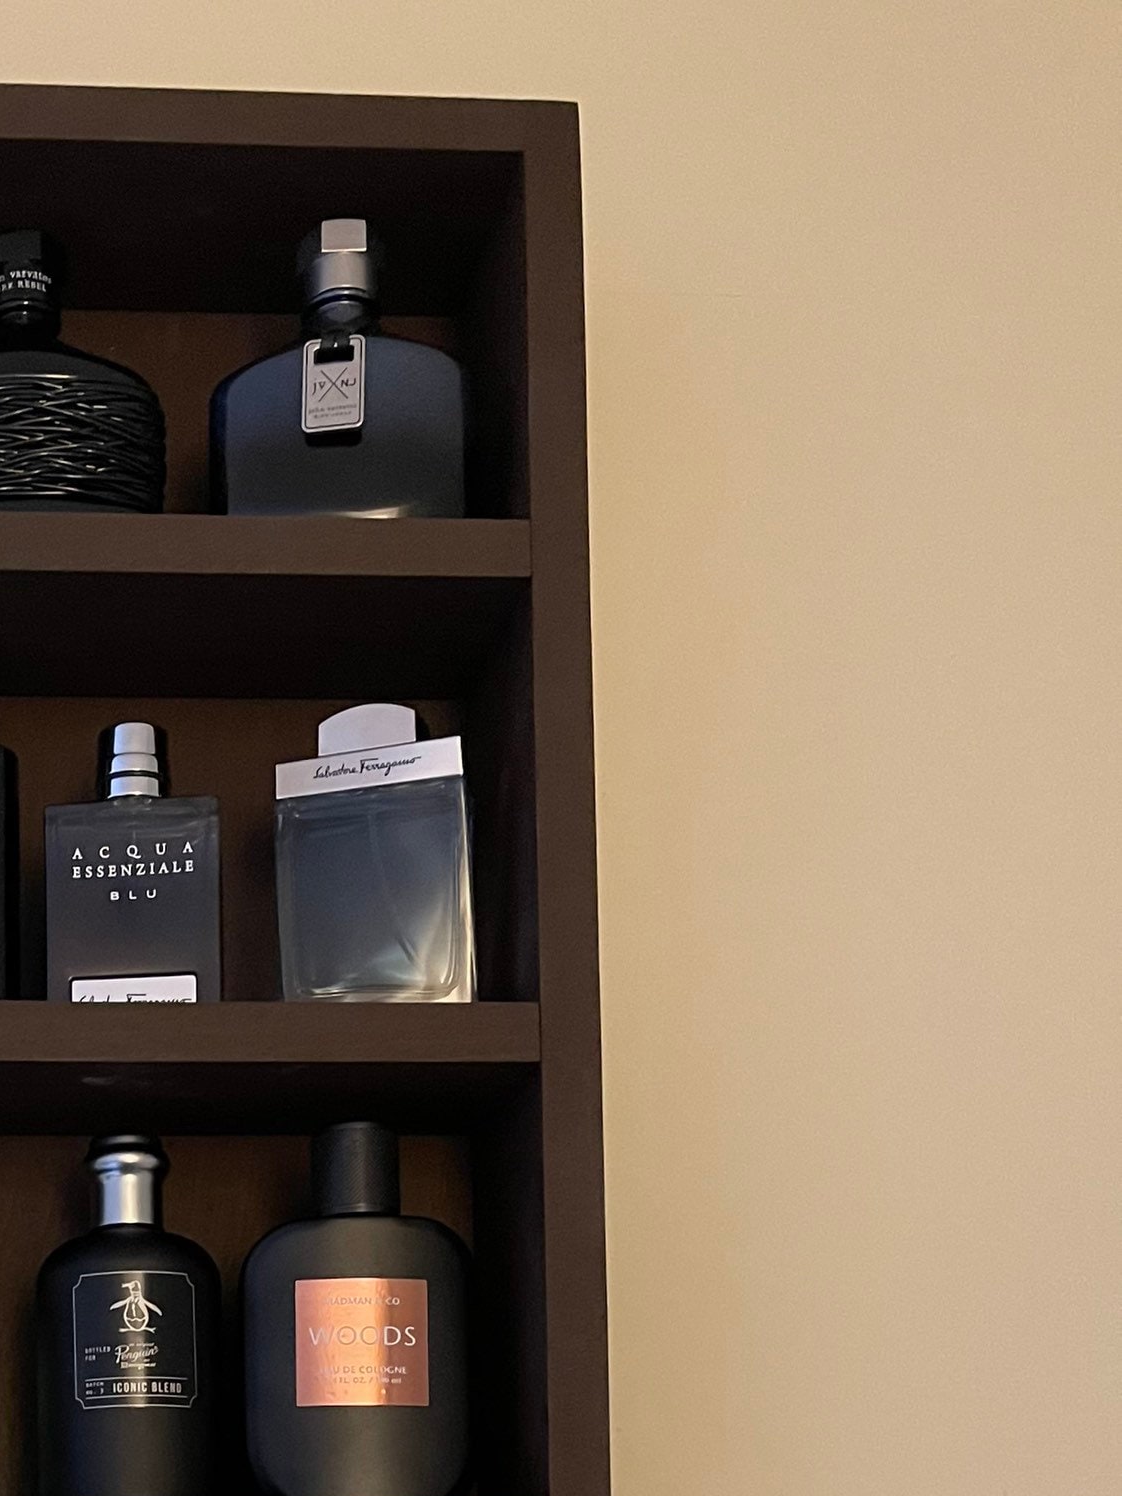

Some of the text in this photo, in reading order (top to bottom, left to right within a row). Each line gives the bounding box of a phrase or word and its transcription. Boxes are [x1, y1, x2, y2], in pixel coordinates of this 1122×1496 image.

[72, 859, 194, 879] ESSENZIALE
[110, 888, 157, 901] BLU
[308, 1326, 417, 1347] WOODS
[342, 1366, 356, 1374] DE
[112, 1381, 182, 1393] ICONIC BLEND
